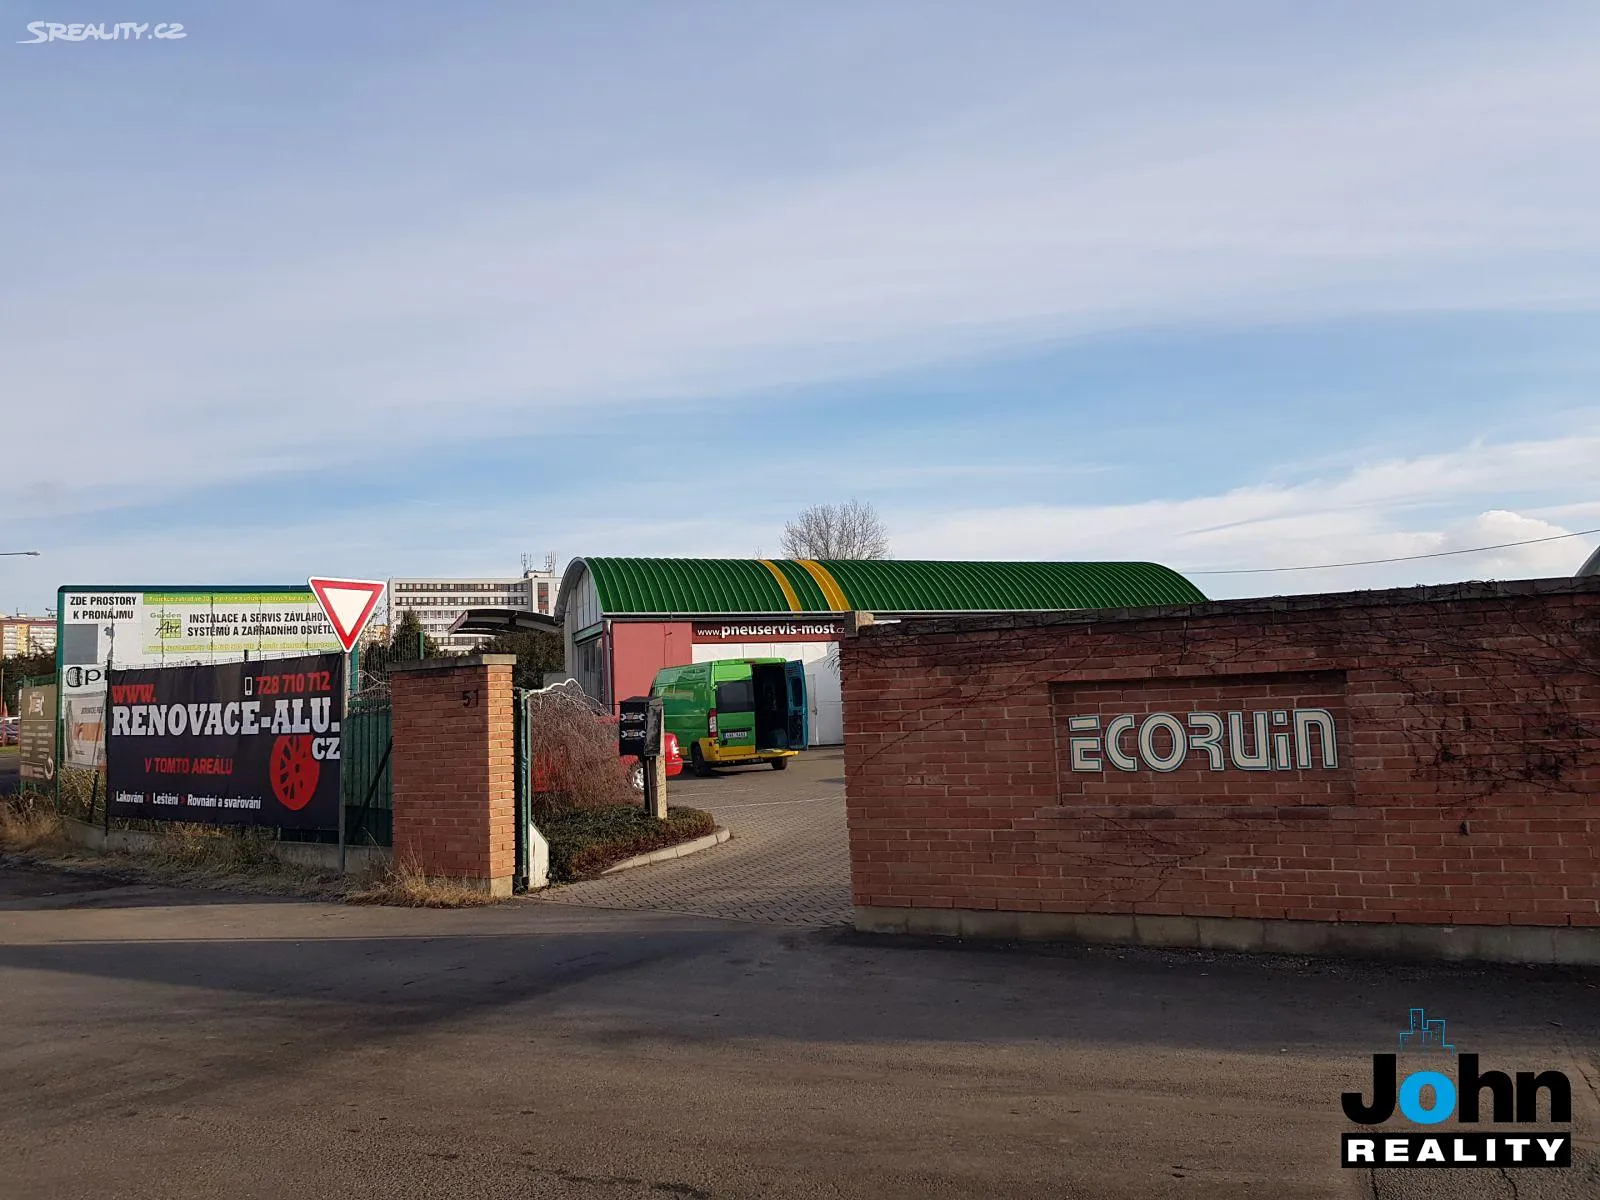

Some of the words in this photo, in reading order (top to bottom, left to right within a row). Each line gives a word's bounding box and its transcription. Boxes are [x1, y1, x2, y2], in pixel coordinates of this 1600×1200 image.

[70, 597, 87, 605] ZDE
[90, 597, 137, 605] PROSTORY
[73, 611, 79, 619] K
[82, 608, 133, 619] PRONÁJMU
[189, 614, 238, 623] INSTALACE
[241, 613, 247, 622] A
[250, 613, 281, 622] SERVIS
[188, 625, 230, 636] SYSTÉMŮ
[233, 627, 239, 635] A
[242, 624, 298, 636] ZAHRADNÍHO
[697, 623, 844, 638] www.pneuservis-most.cz
[257, 675, 279, 695] 728
[284, 674, 303, 693] 710
[309, 672, 331, 691] 712
[463, 689, 478, 706] 51
[112, 697, 340, 736] RENOVACE-ALU.
[145, 758, 151, 772] V
[154, 758, 189, 774] TOMTO
[192, 755, 233, 774] AREÁLU
[116, 790, 144, 803] Lakování
[153, 792, 179, 805] Leštění
[187, 793, 217, 808] Rovnání
[224, 797, 261, 809] svařování
